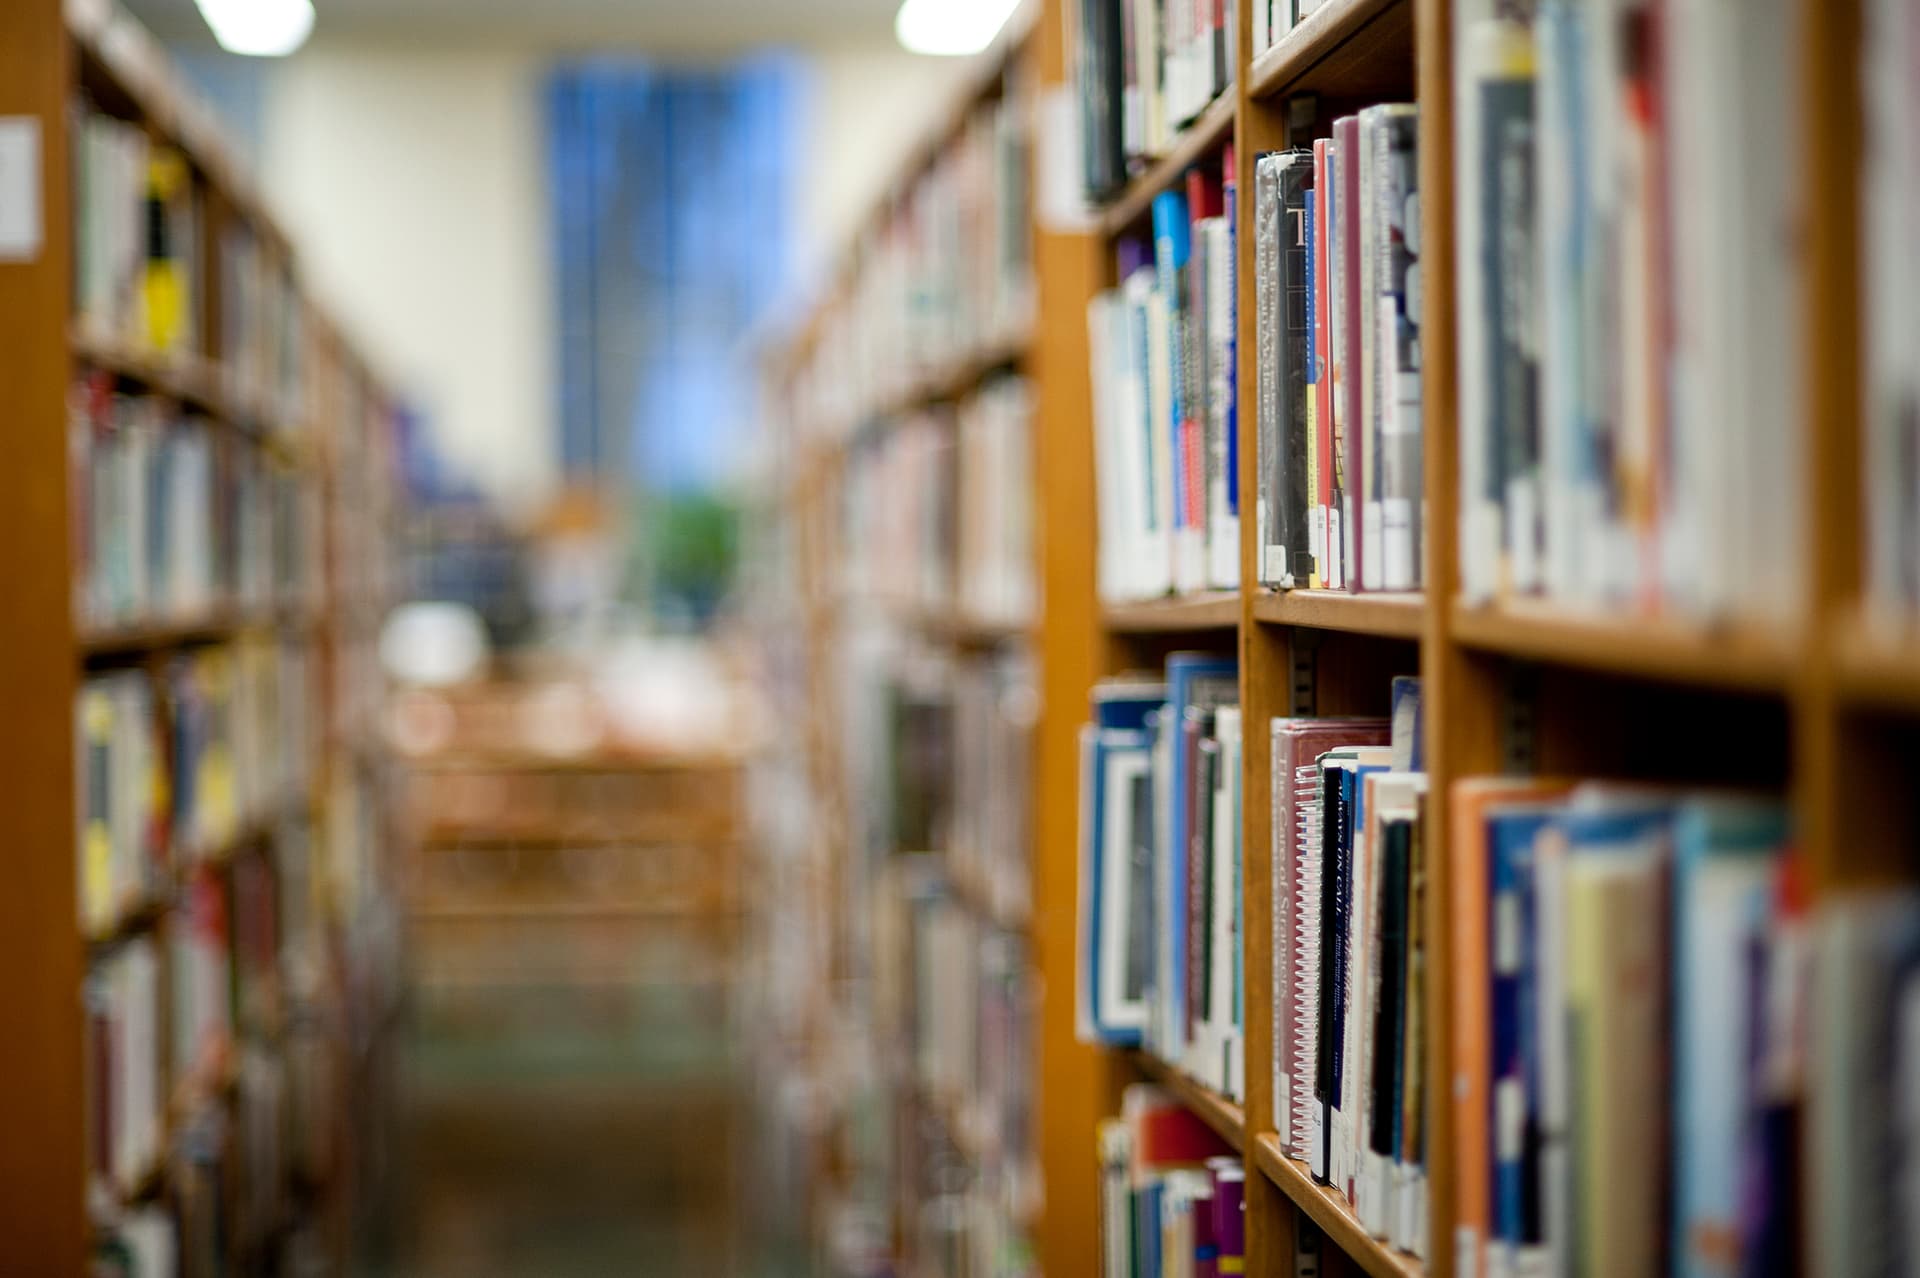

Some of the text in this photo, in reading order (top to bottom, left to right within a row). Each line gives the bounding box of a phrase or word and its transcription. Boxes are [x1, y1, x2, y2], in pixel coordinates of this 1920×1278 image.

[1279, 754, 1289, 799] The
[1279, 805, 1289, 861] Care
[1279, 866, 1290, 889] of
[1337, 847, 1343, 873] ON
